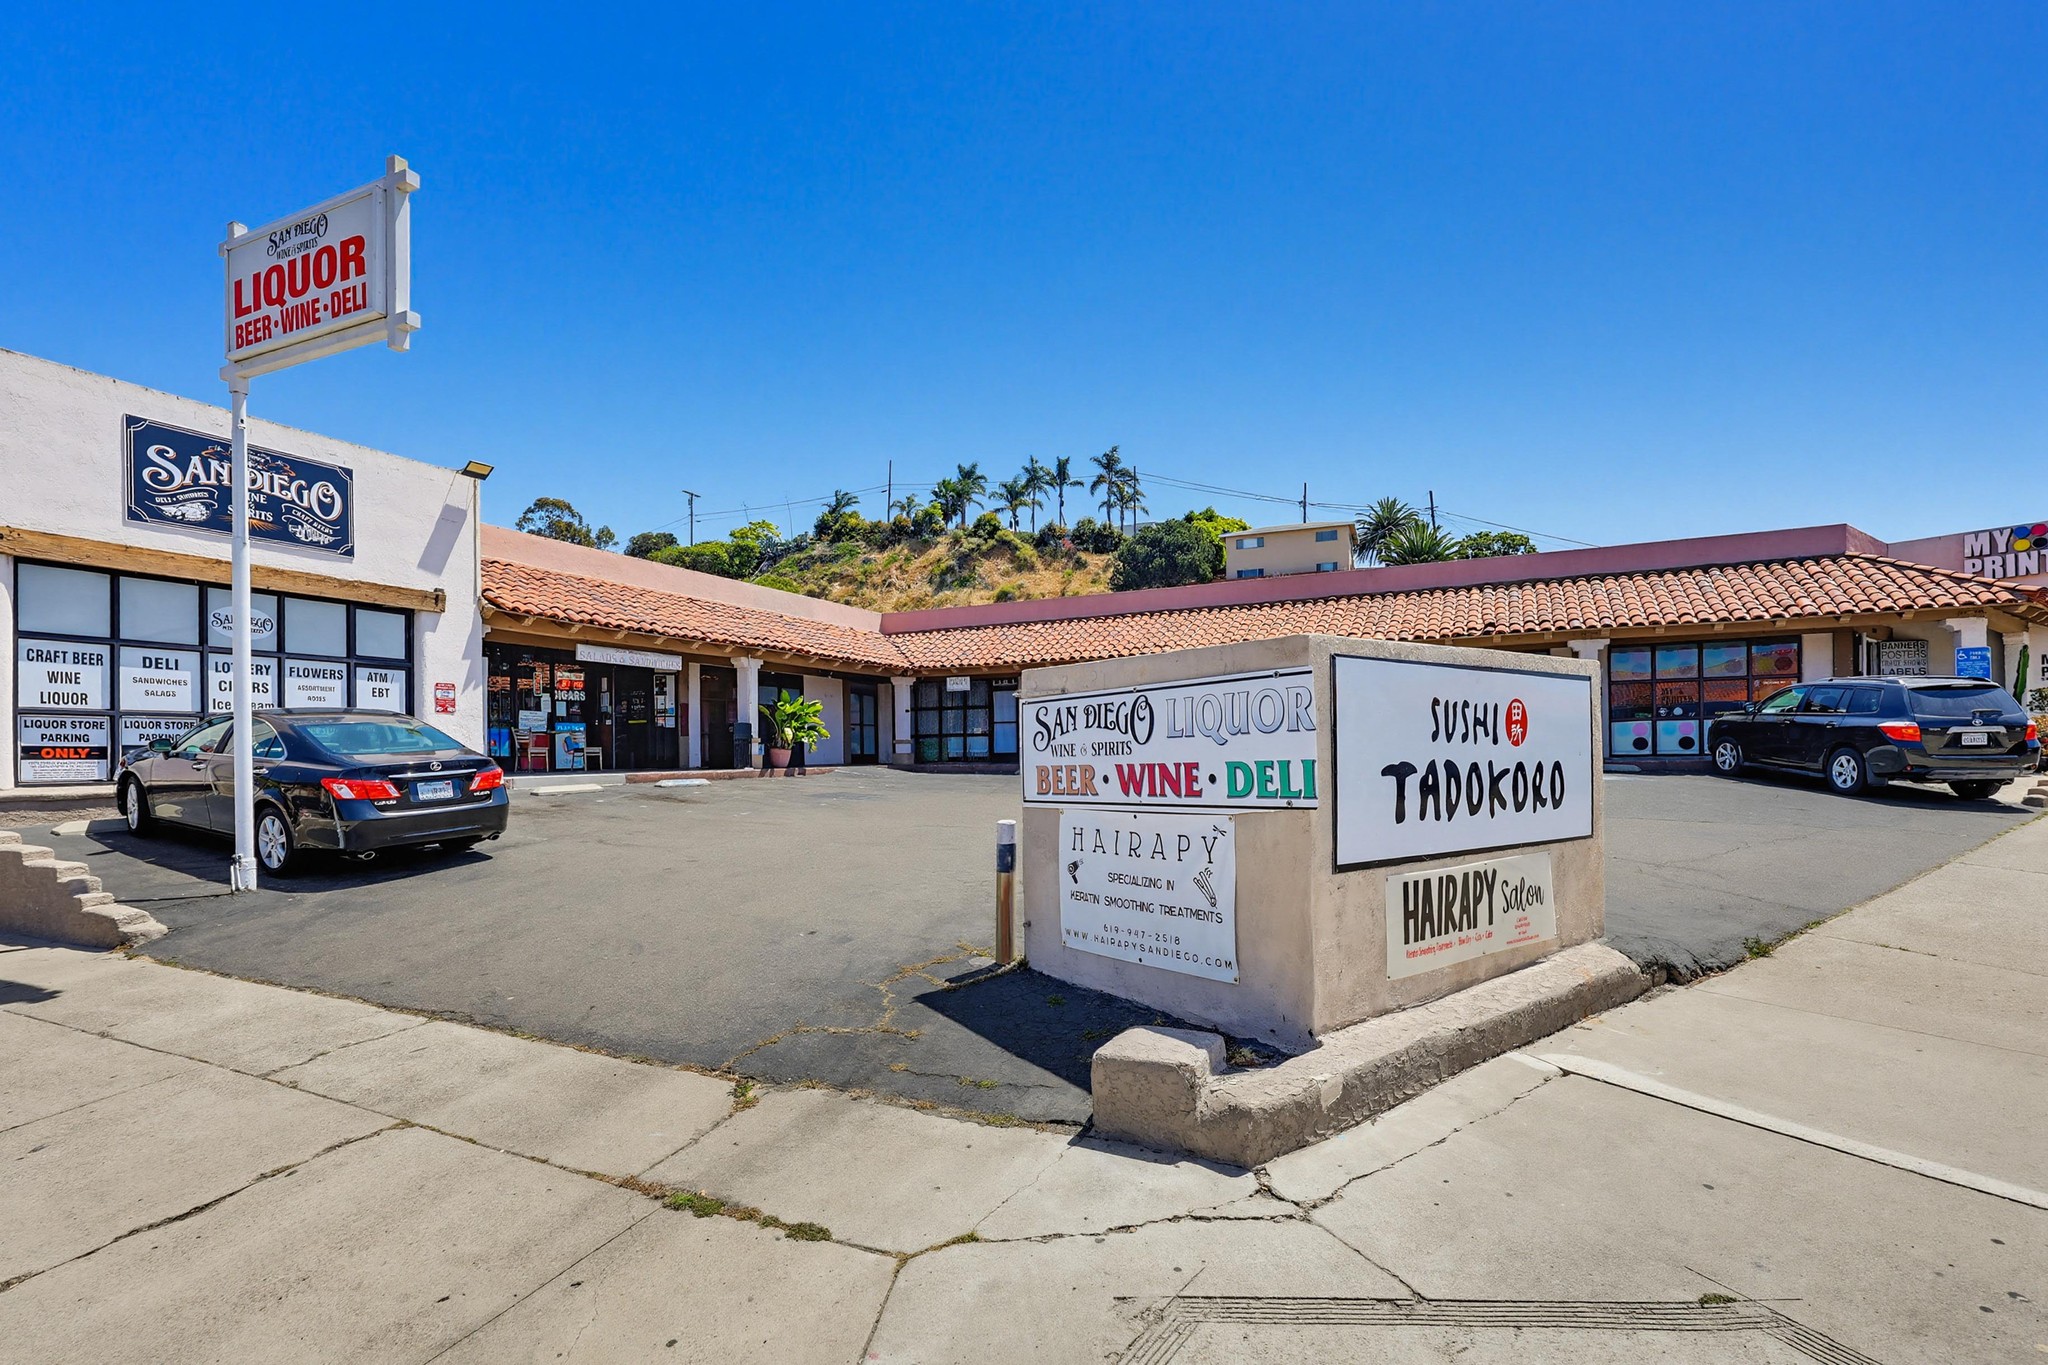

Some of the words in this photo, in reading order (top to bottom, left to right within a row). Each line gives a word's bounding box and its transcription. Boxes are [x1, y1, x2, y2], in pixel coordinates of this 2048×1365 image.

[267, 227, 291, 256] SAN
[294, 213, 328, 237] DIEGO
[296, 236, 318, 253] SPIRITS
[234, 235, 367, 319] LIQUOR
[235, 314, 272, 349] BEER
[280, 297, 321, 334] WINE
[330, 282, 367, 318] DELI
[1964, 527, 2013, 557] MY
[1881, 641, 1926, 650] BANNERS
[26, 648, 69, 665] CRAFT
[72, 651, 104, 666] BEER
[580, 651, 617, 664] SALADS
[1881, 650, 1927, 660] POSTERS
[142, 656, 179, 671] DELI
[47, 670, 81, 685] WINE
[289, 667, 344, 680] FLOWERS
[367, 672, 388, 683] ATM
[1881, 667, 1927, 676] LABELS
[132, 676, 188, 687] SANDWICHES
[218, 680, 269, 694] CIRS
[40, 691, 88, 706] LIQUOR
[144, 689, 177, 698] SALADS
[371, 687, 390, 698] EBT
[213, 698, 231, 710] Ice
[1033, 705, 1078, 751] SAN
[1083, 694, 1155, 746] DIEGO
[1166, 685, 1317, 746] LIQUOR
[1431, 696, 1499, 745] SUSHI
[24, 719, 67, 730] LIQUOR
[70, 720, 106, 730] STORE
[124, 720, 162, 730] LIQUOR
[40, 733, 90, 743] PARKING
[40, 748, 91, 759] ONLY
[1050, 743, 1077, 758] WINE
[1091, 741, 1133, 756] SPIRITS
[1036, 764, 1099, 796] BEER
[1115, 761, 1204, 798] WINE
[1225, 759, 1318, 800] DELI
[1380, 758, 1565, 824] TADOKORO
[1072, 826, 1217, 864] HAIRAPY
[1107, 872, 1163, 890] SPECIALIZING
[1166, 880, 1175, 891] IN
[1070, 890, 1100, 905] KERATIN
[1104, 896, 1155, 914] SMOOTHING
[1159, 904, 1223, 924] TREATMENTS
[1403, 868, 1498, 945] HAIRAPY
[1501, 877, 1545, 914] Salon
[1065, 928, 1233, 970] WWW.HAIRAPYSANDIEGO.COM
